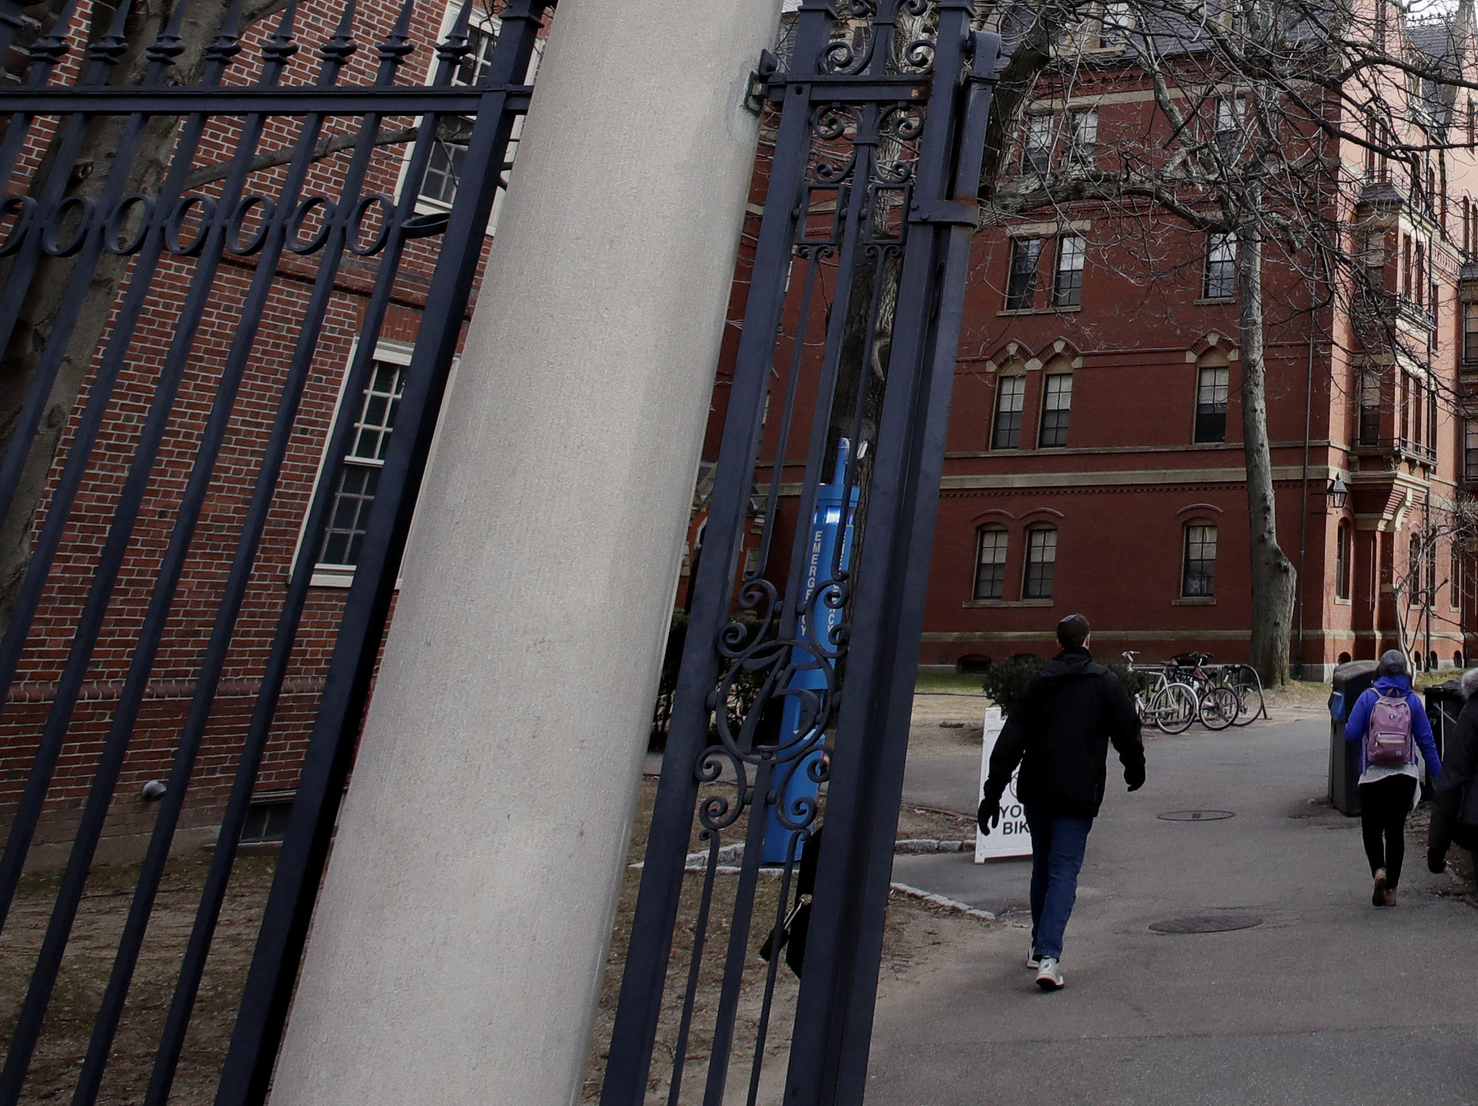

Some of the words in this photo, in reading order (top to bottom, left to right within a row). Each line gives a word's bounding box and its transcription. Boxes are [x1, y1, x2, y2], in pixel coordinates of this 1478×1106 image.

[800, 530, 823, 637] EMERGECY
[999, 804, 1025, 819] YO
[1002, 820, 1032, 835] BIK
